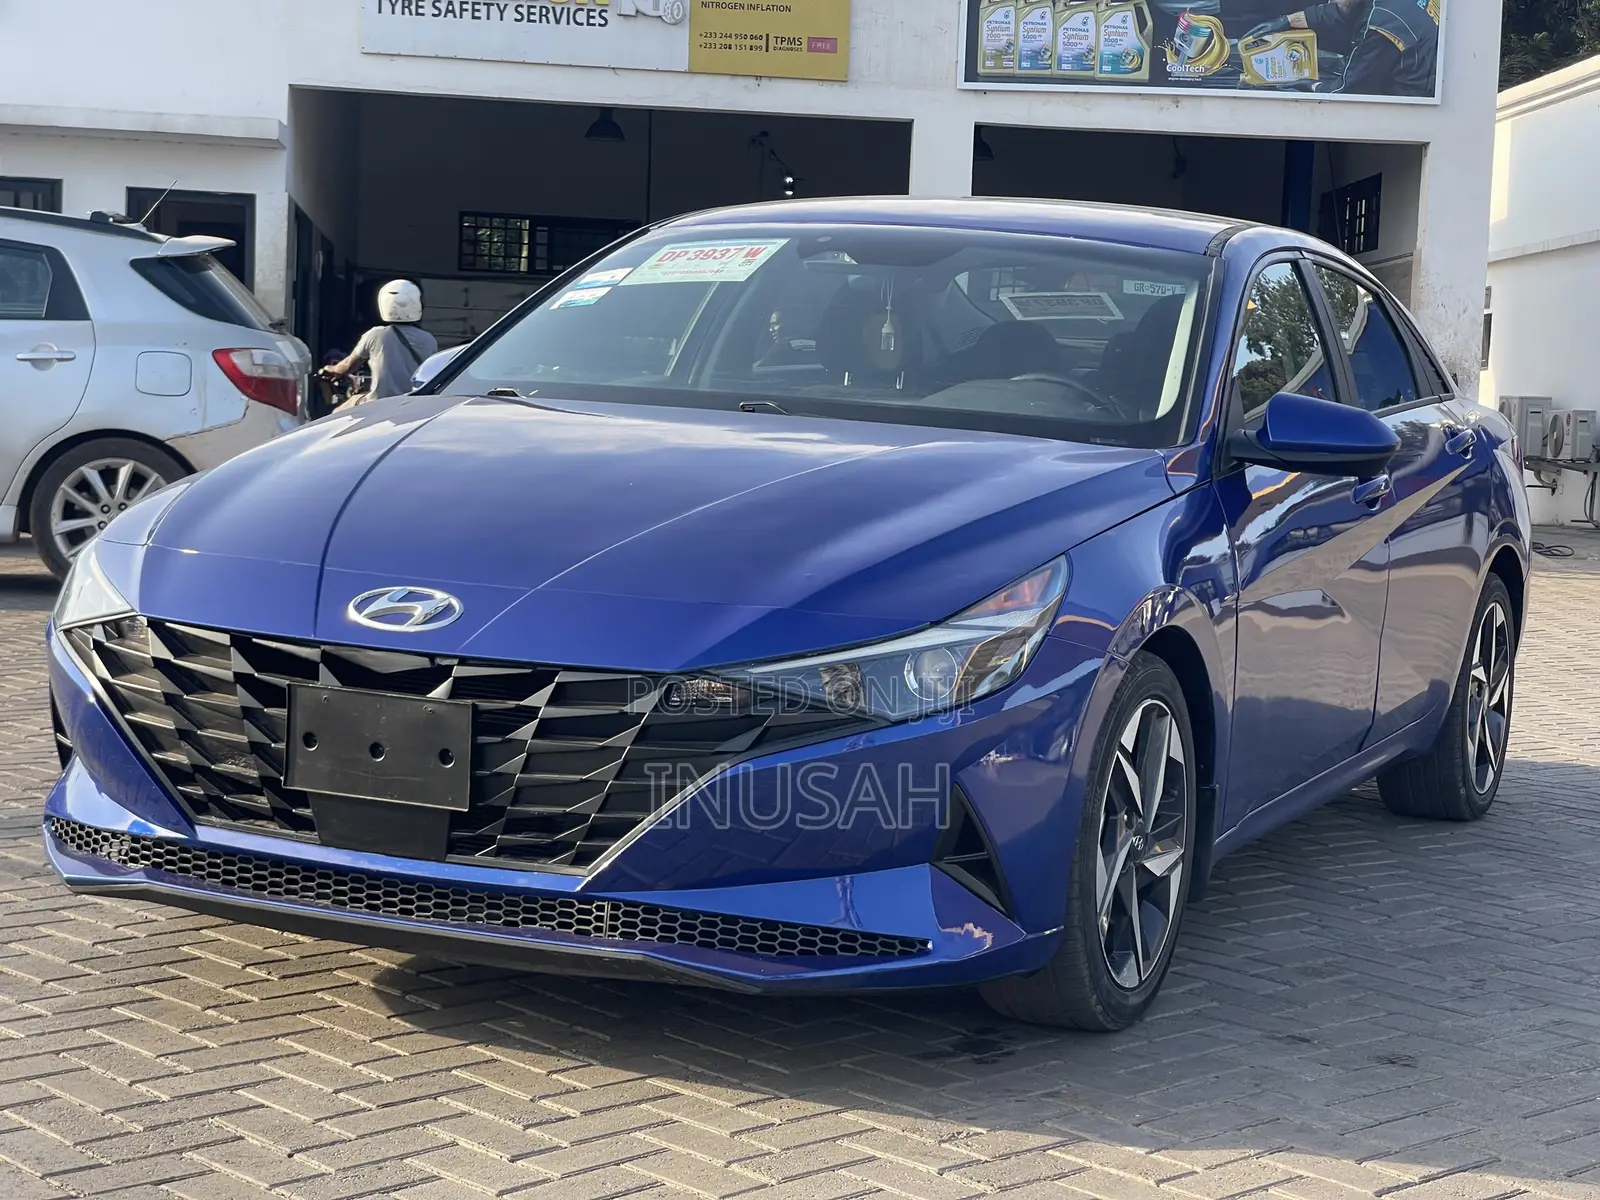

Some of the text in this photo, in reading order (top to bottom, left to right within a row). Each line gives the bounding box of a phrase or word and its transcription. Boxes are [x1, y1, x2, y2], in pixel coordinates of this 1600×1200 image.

[700, 1, 792, 12] NITROGEN INFLATION
[377, 0, 609, 27] TYRE SAFETY SERVICES
[773, 36, 803, 46] TPMS
[811, 42, 831, 50] FREE
[657, 250, 686, 262] DP
[743, 247, 768, 258] W
